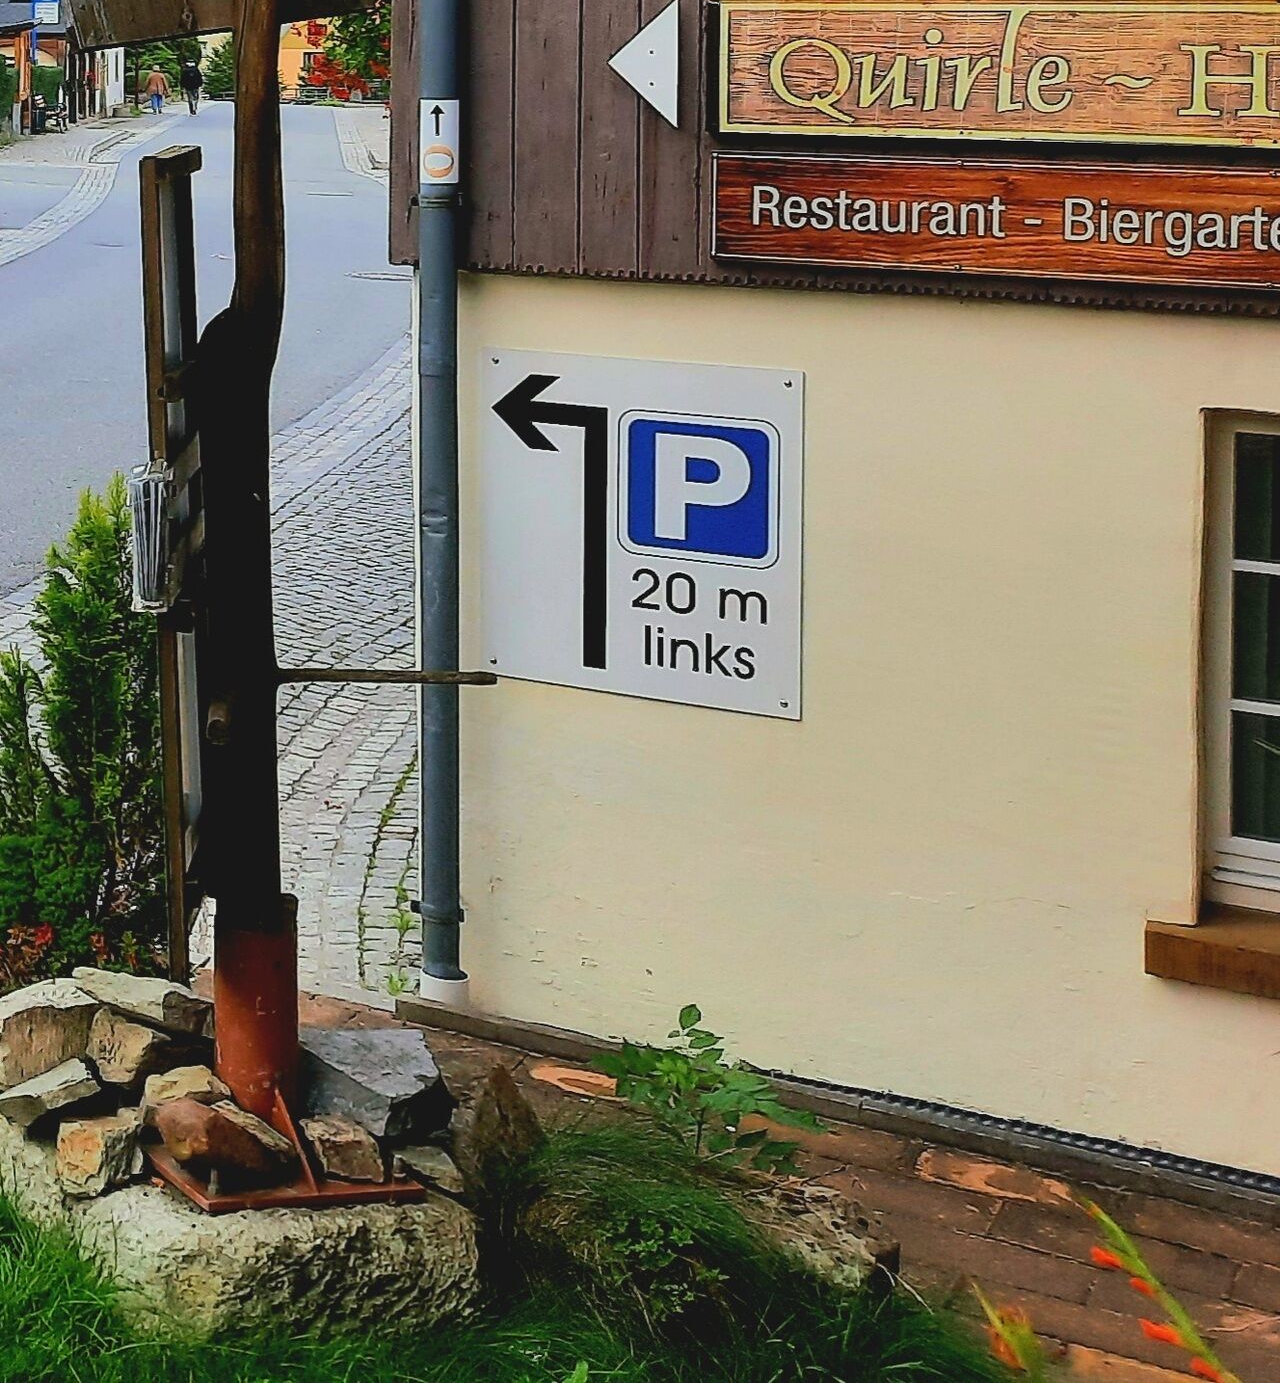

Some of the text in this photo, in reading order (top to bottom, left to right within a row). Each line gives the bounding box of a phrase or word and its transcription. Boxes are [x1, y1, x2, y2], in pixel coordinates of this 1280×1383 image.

[768, 8, 1073, 123] Quirle
[1177, 44, 1280, 117] H
[751, 184, 1007, 239] Restaurant
[653, 432, 752, 541] P
[631, 568, 768, 626] 20 m
[643, 624, 757, 681] links
